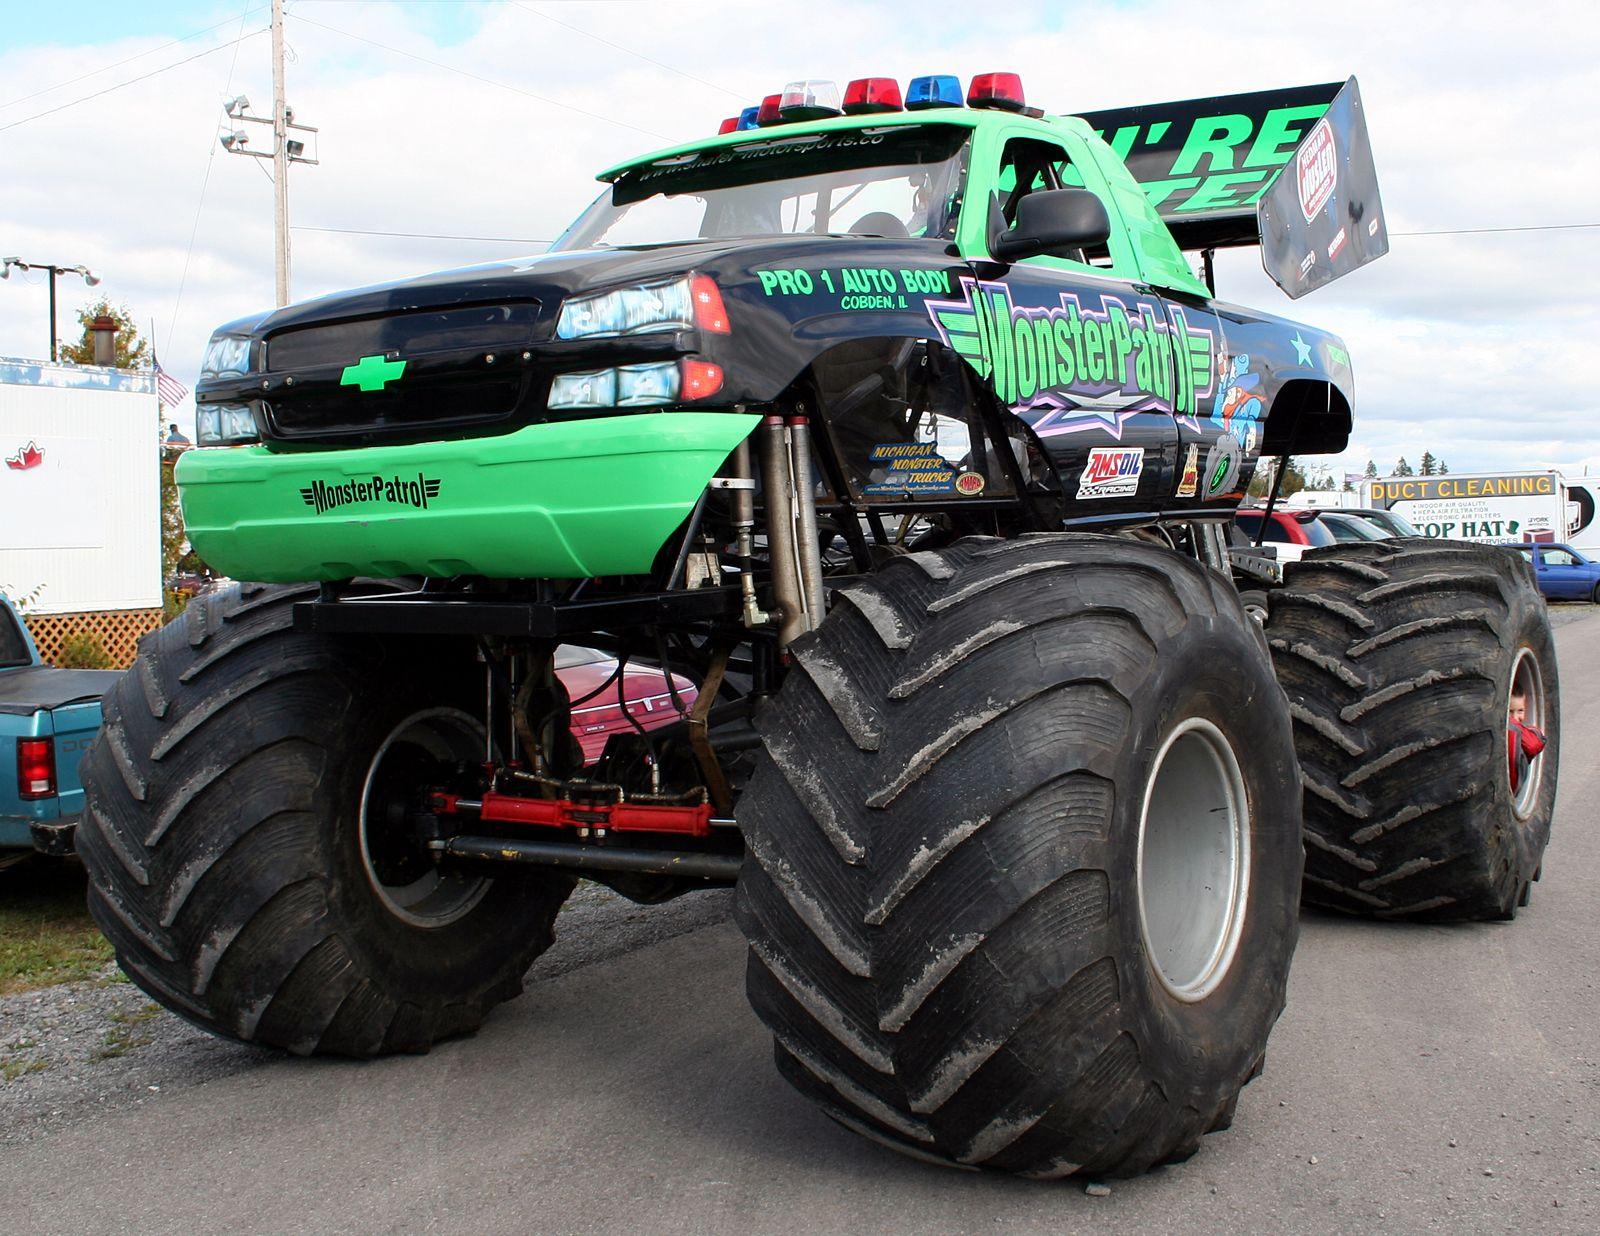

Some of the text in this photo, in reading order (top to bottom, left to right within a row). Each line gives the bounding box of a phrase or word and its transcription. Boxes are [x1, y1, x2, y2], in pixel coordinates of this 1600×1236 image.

[757, 267, 951, 296] PRO 1 AUTO BODY
[840, 295, 909, 310] COBDEN, IL
[972, 287, 1195, 418] MonsterPatrol
[874, 445, 933, 458] MICHIGAN
[890, 458, 943, 470] MONSTER
[1085, 453, 1141, 483] AMSOIL
[908, 471, 953, 483] TRUCKS
[311, 472, 428, 515] MonsterPatrol
[1098, 484, 1136, 496] RACING
[1371, 477, 1551, 500] DUCT CLEANING
[1412, 520, 1505, 538] TOP HAT
